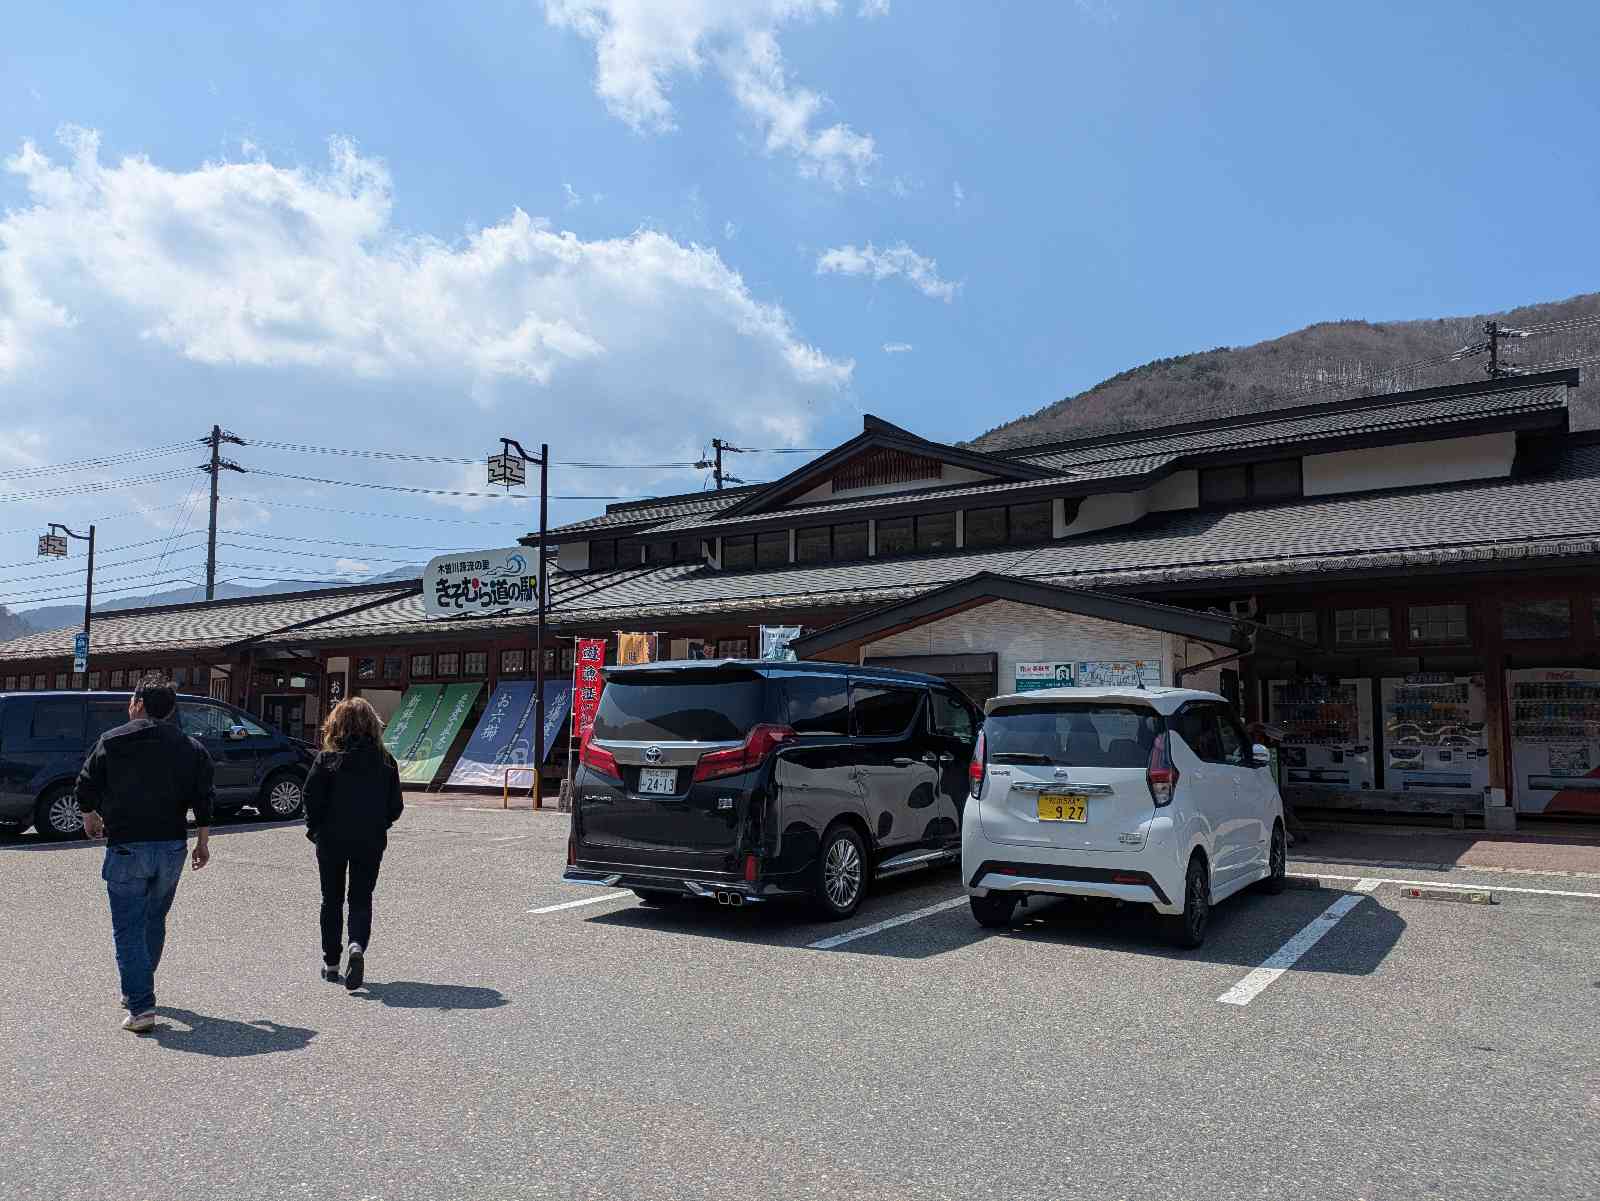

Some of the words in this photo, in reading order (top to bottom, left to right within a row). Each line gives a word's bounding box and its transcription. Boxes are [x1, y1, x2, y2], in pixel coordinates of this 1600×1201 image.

[435, 575, 540, 609] きそむら道の駅
